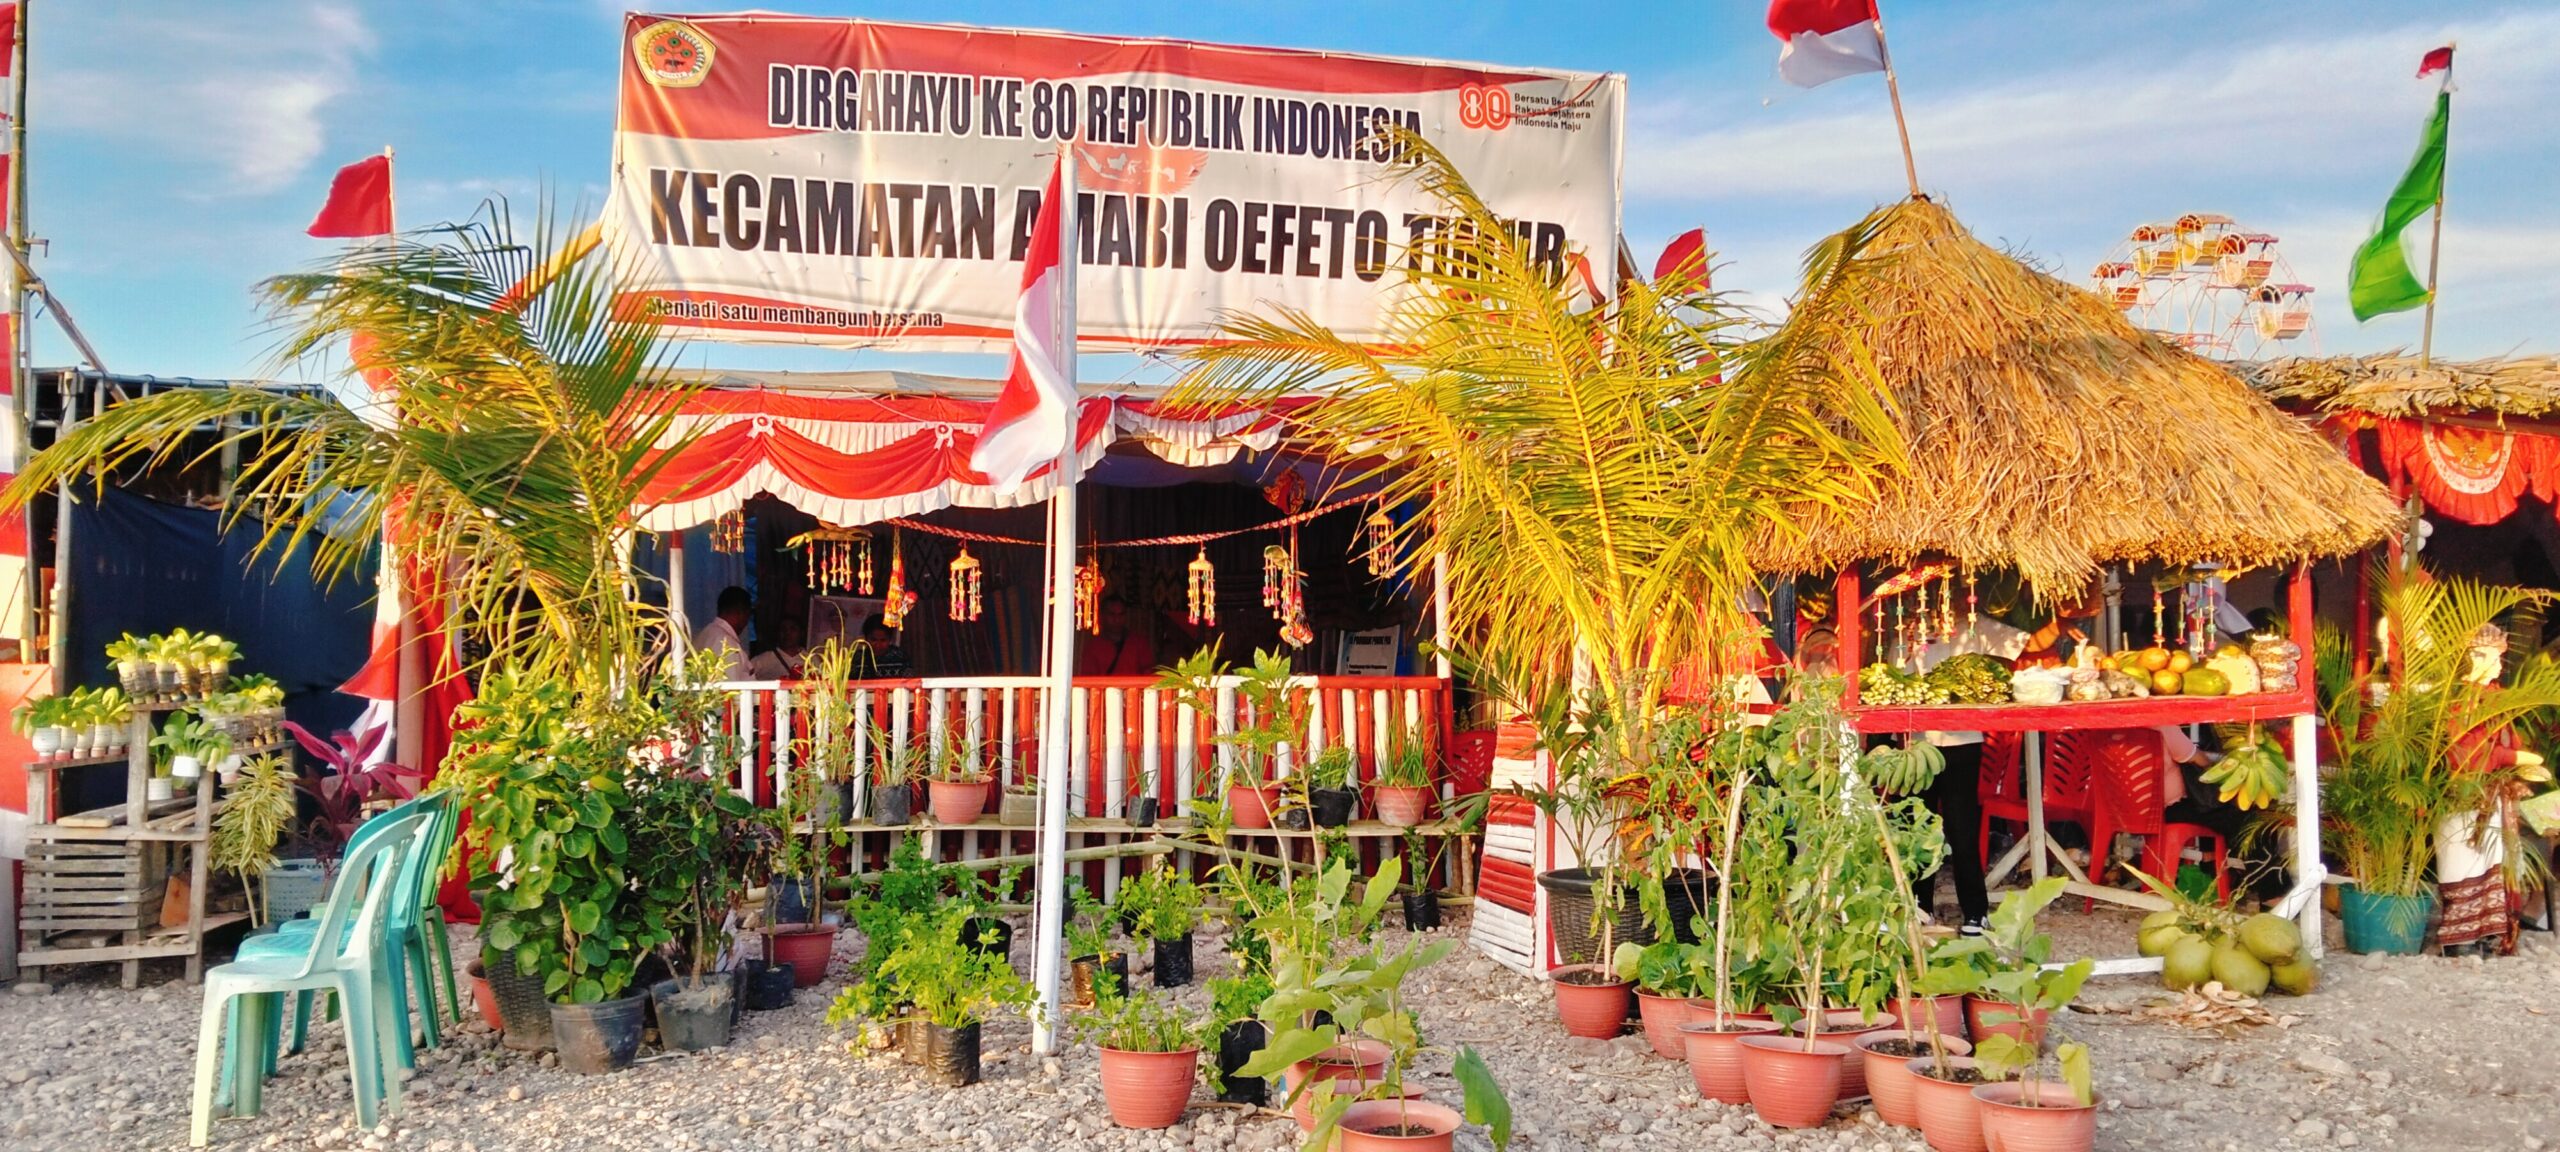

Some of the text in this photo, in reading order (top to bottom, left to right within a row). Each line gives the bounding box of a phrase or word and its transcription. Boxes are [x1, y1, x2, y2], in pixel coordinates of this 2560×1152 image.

[770, 65, 1424, 165] DIRGAHAYU KE 80 REPUBLIK INDONESIA
[1459, 83, 1511, 130] 80
[1514, 92, 1549, 105] Bersatu
[1514, 116, 1581, 132] Indonesia Maju
[649, 169, 995, 260] KECAMATAN
[1203, 198, 1388, 282] OEFETO
[721, 302, 758, 321] satu
[762, 306, 868, 328] membangun
[872, 310, 943, 327] bersama
